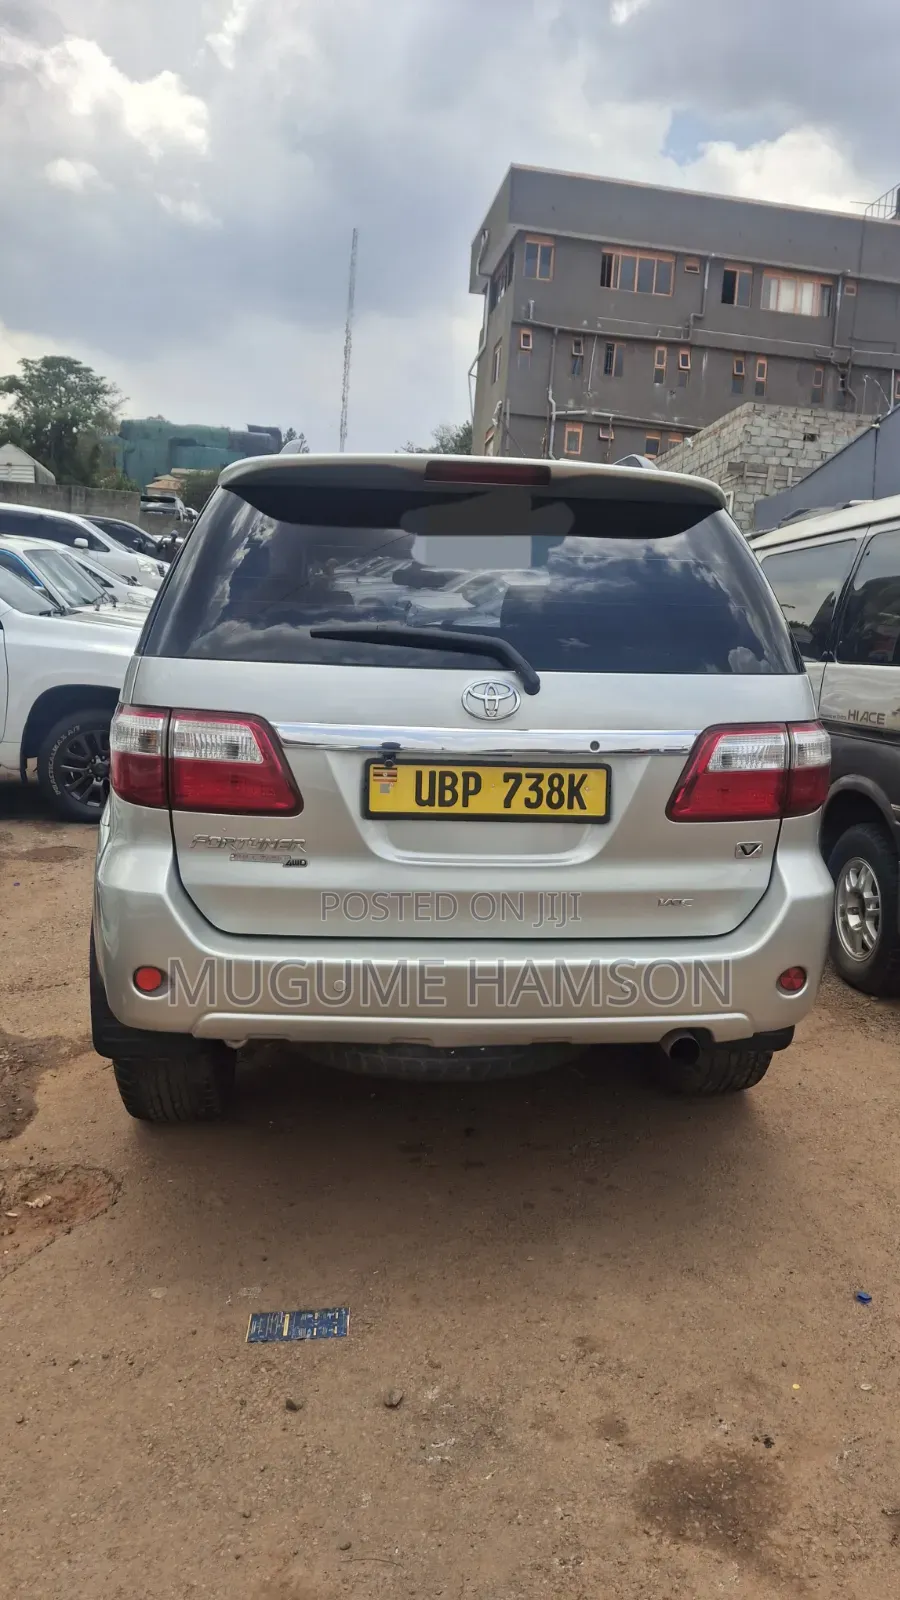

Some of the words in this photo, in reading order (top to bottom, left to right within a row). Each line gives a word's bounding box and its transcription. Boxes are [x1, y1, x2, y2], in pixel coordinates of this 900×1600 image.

[847, 709, 886, 725] HIACE
[414, 769, 482, 808] UBP
[502, 771, 588, 811] 738K
[189, 834, 307, 853] FORTUNER
[284, 859, 307, 867] 4WD
